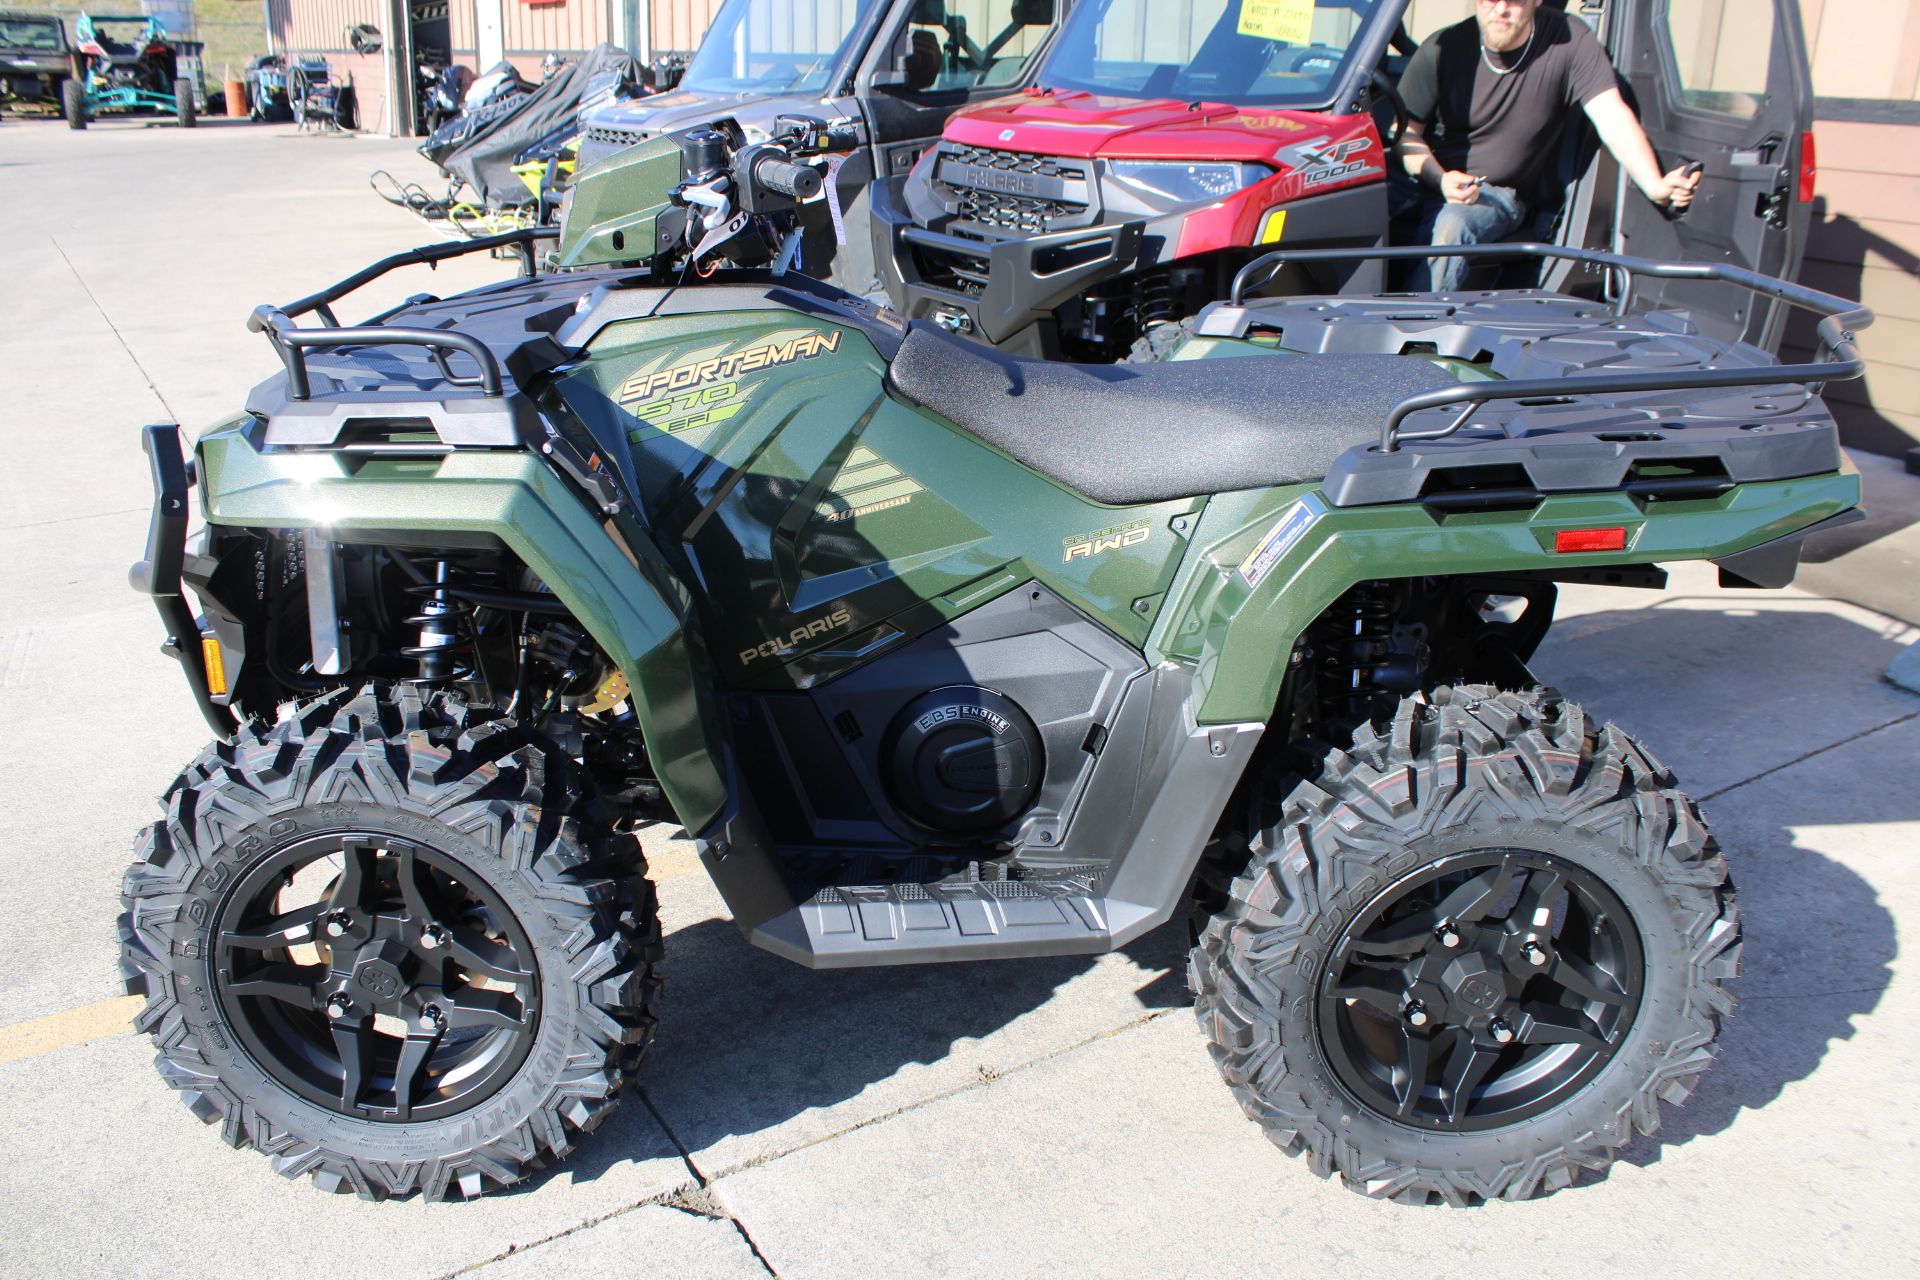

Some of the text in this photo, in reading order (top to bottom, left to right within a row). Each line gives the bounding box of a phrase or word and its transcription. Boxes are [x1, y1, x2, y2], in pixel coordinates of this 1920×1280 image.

[1285, 137, 1373, 177] XP
[1304, 160, 1366, 185] 1000
[966, 169, 1036, 193] POLARIS
[619, 330, 843, 405] SPORTSMAN
[637, 381, 738, 432] 570
[668, 412, 711, 432] EFI
[824, 495, 913, 524] 40 ANNIVERSARY
[1063, 518, 1153, 546] ON DEMAND
[1063, 526, 1151, 563] AWD
[739, 608, 852, 666] POLARIS
[919, 706, 1009, 730] EBS ENGINE
[187, 818, 297, 928] DURO
[1296, 850, 1420, 985] DURO
